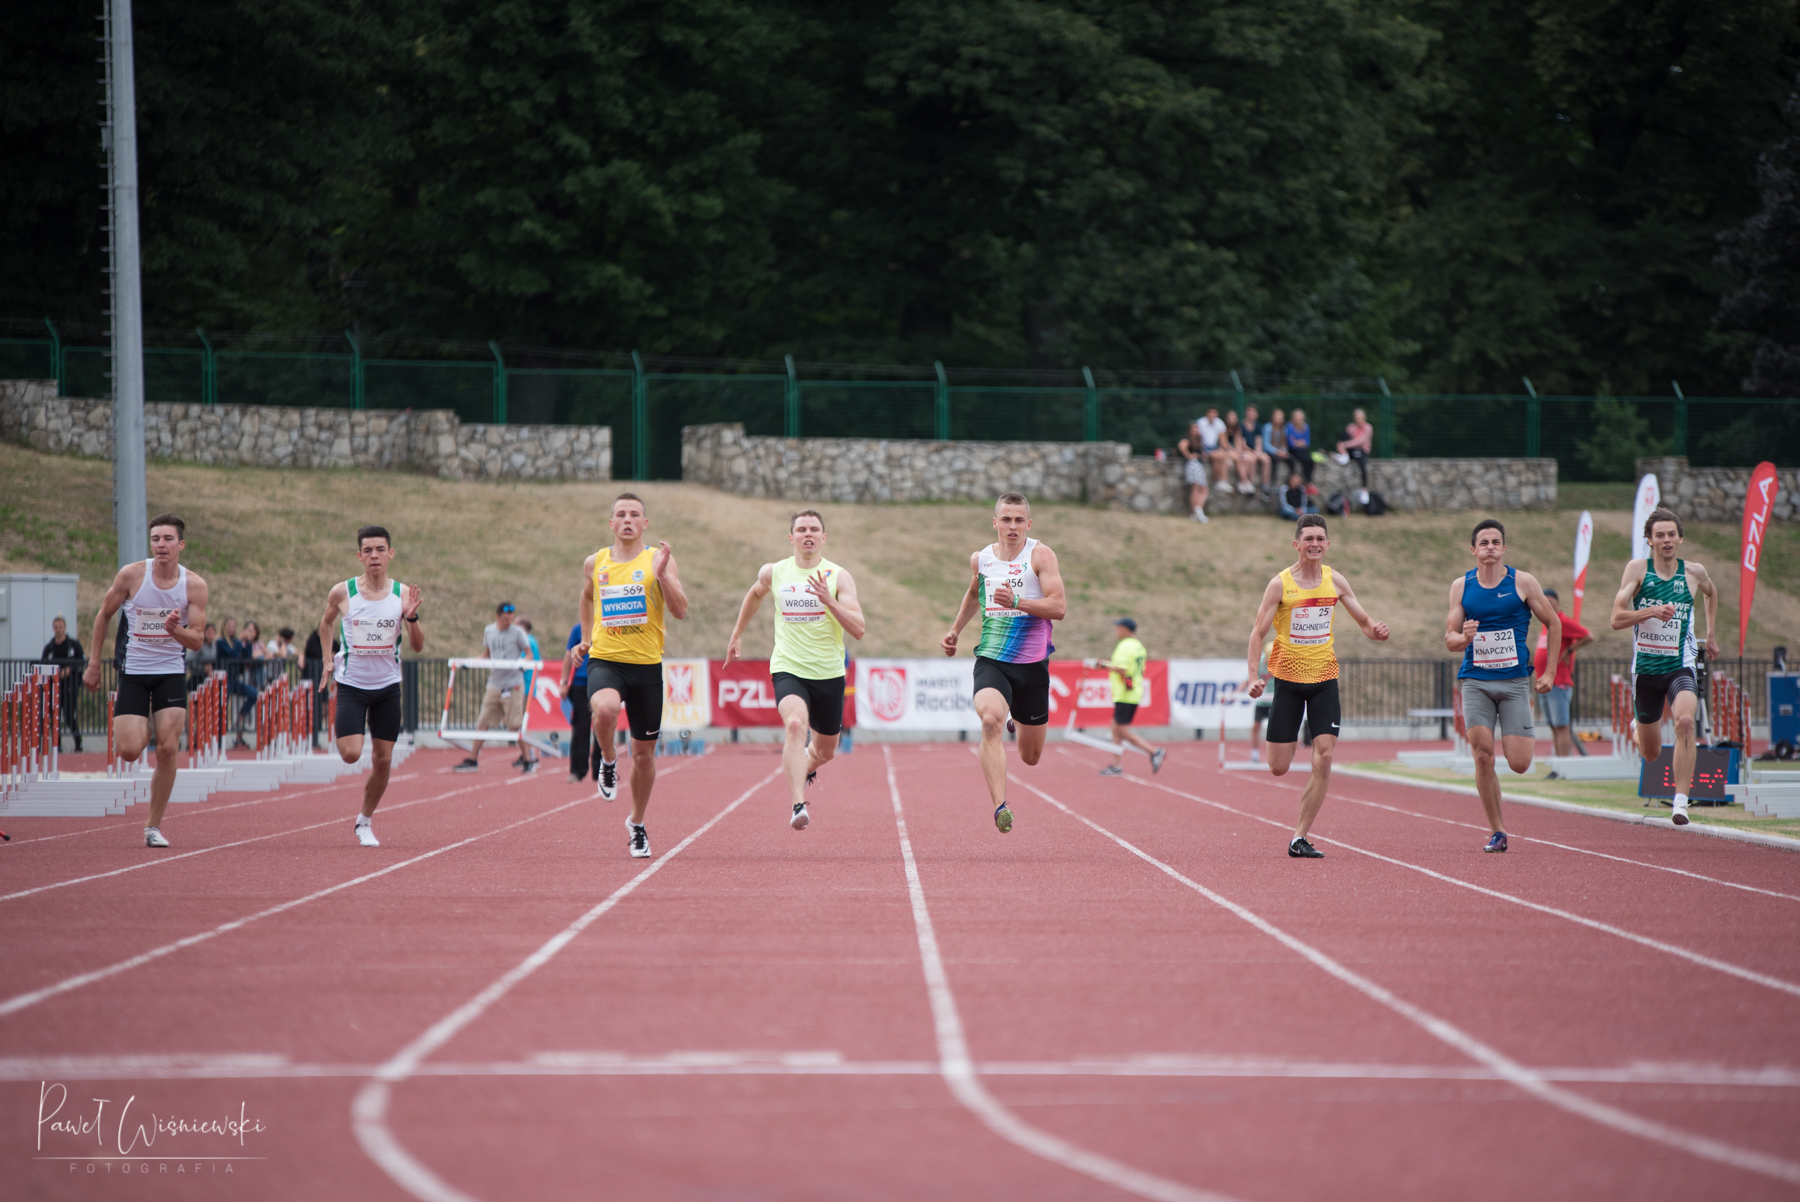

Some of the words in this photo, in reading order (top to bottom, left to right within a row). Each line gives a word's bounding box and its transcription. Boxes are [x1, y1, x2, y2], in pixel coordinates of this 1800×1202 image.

[1744, 477, 1774, 572] PZLA
[623, 585, 642, 596] 569
[604, 600, 644, 612] WYKROTA
[785, 598, 818, 607] WRÓBEL
[1640, 598, 1663, 606] AZS
[1667, 601, 1690, 611] AWF
[1318, 608, 1330, 617] 25
[376, 620, 394, 628] 630
[1292, 621, 1330, 631] SZACHNIEWICZ
[1662, 620, 1680, 629] 241
[366, 633, 382, 641] ŻOK
[1494, 631, 1513, 641] 322
[1640, 632, 1677, 642] GŁĘBOCKI
[1475, 645, 1514, 656] KNAPCZYK
